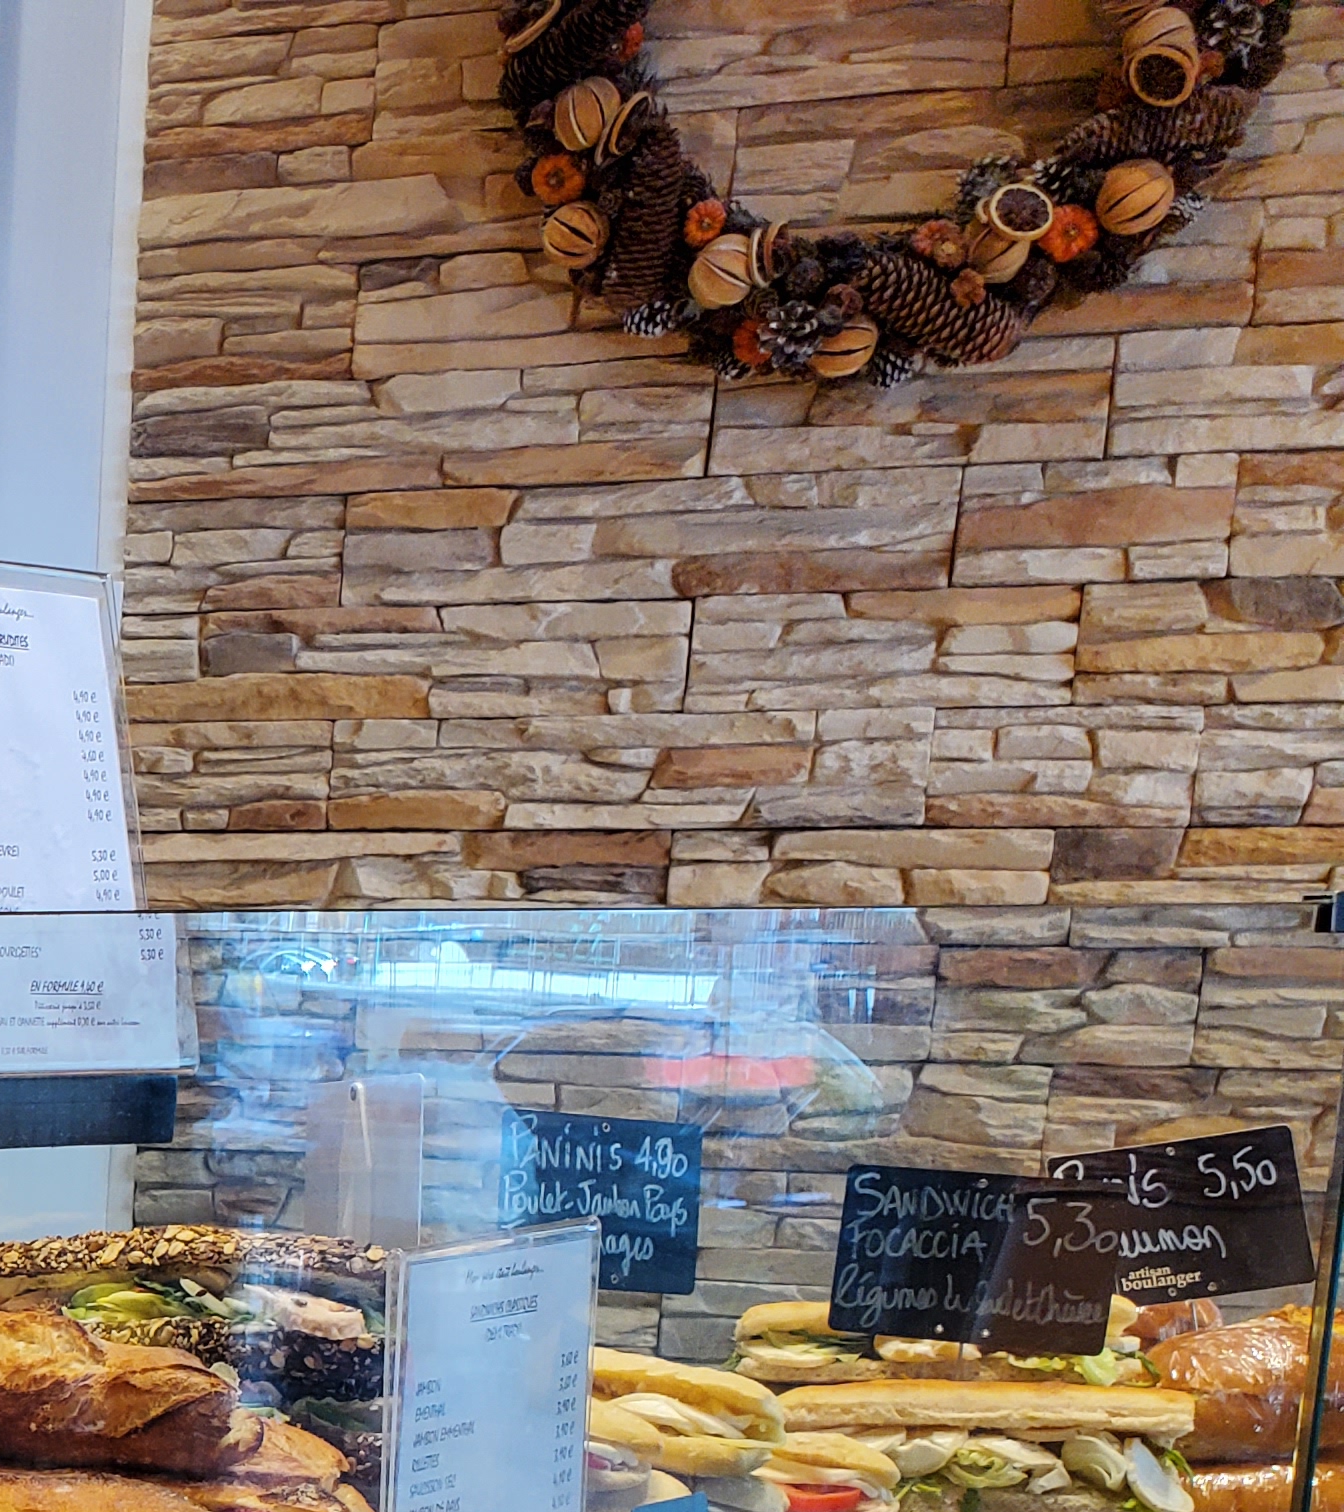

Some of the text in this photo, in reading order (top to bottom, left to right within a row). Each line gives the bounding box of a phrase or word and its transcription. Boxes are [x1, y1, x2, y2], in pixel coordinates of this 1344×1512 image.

[30, 980, 79, 992] EN FORMULE
[634, 1135, 689, 1179] 4,90
[1196, 1145, 1278, 1200] 5,50
[1023, 1197, 1118, 1258] 5,30
[1121, 1270, 1202, 1293] boulanger
[1128, 1266, 1172, 1281] artisan
